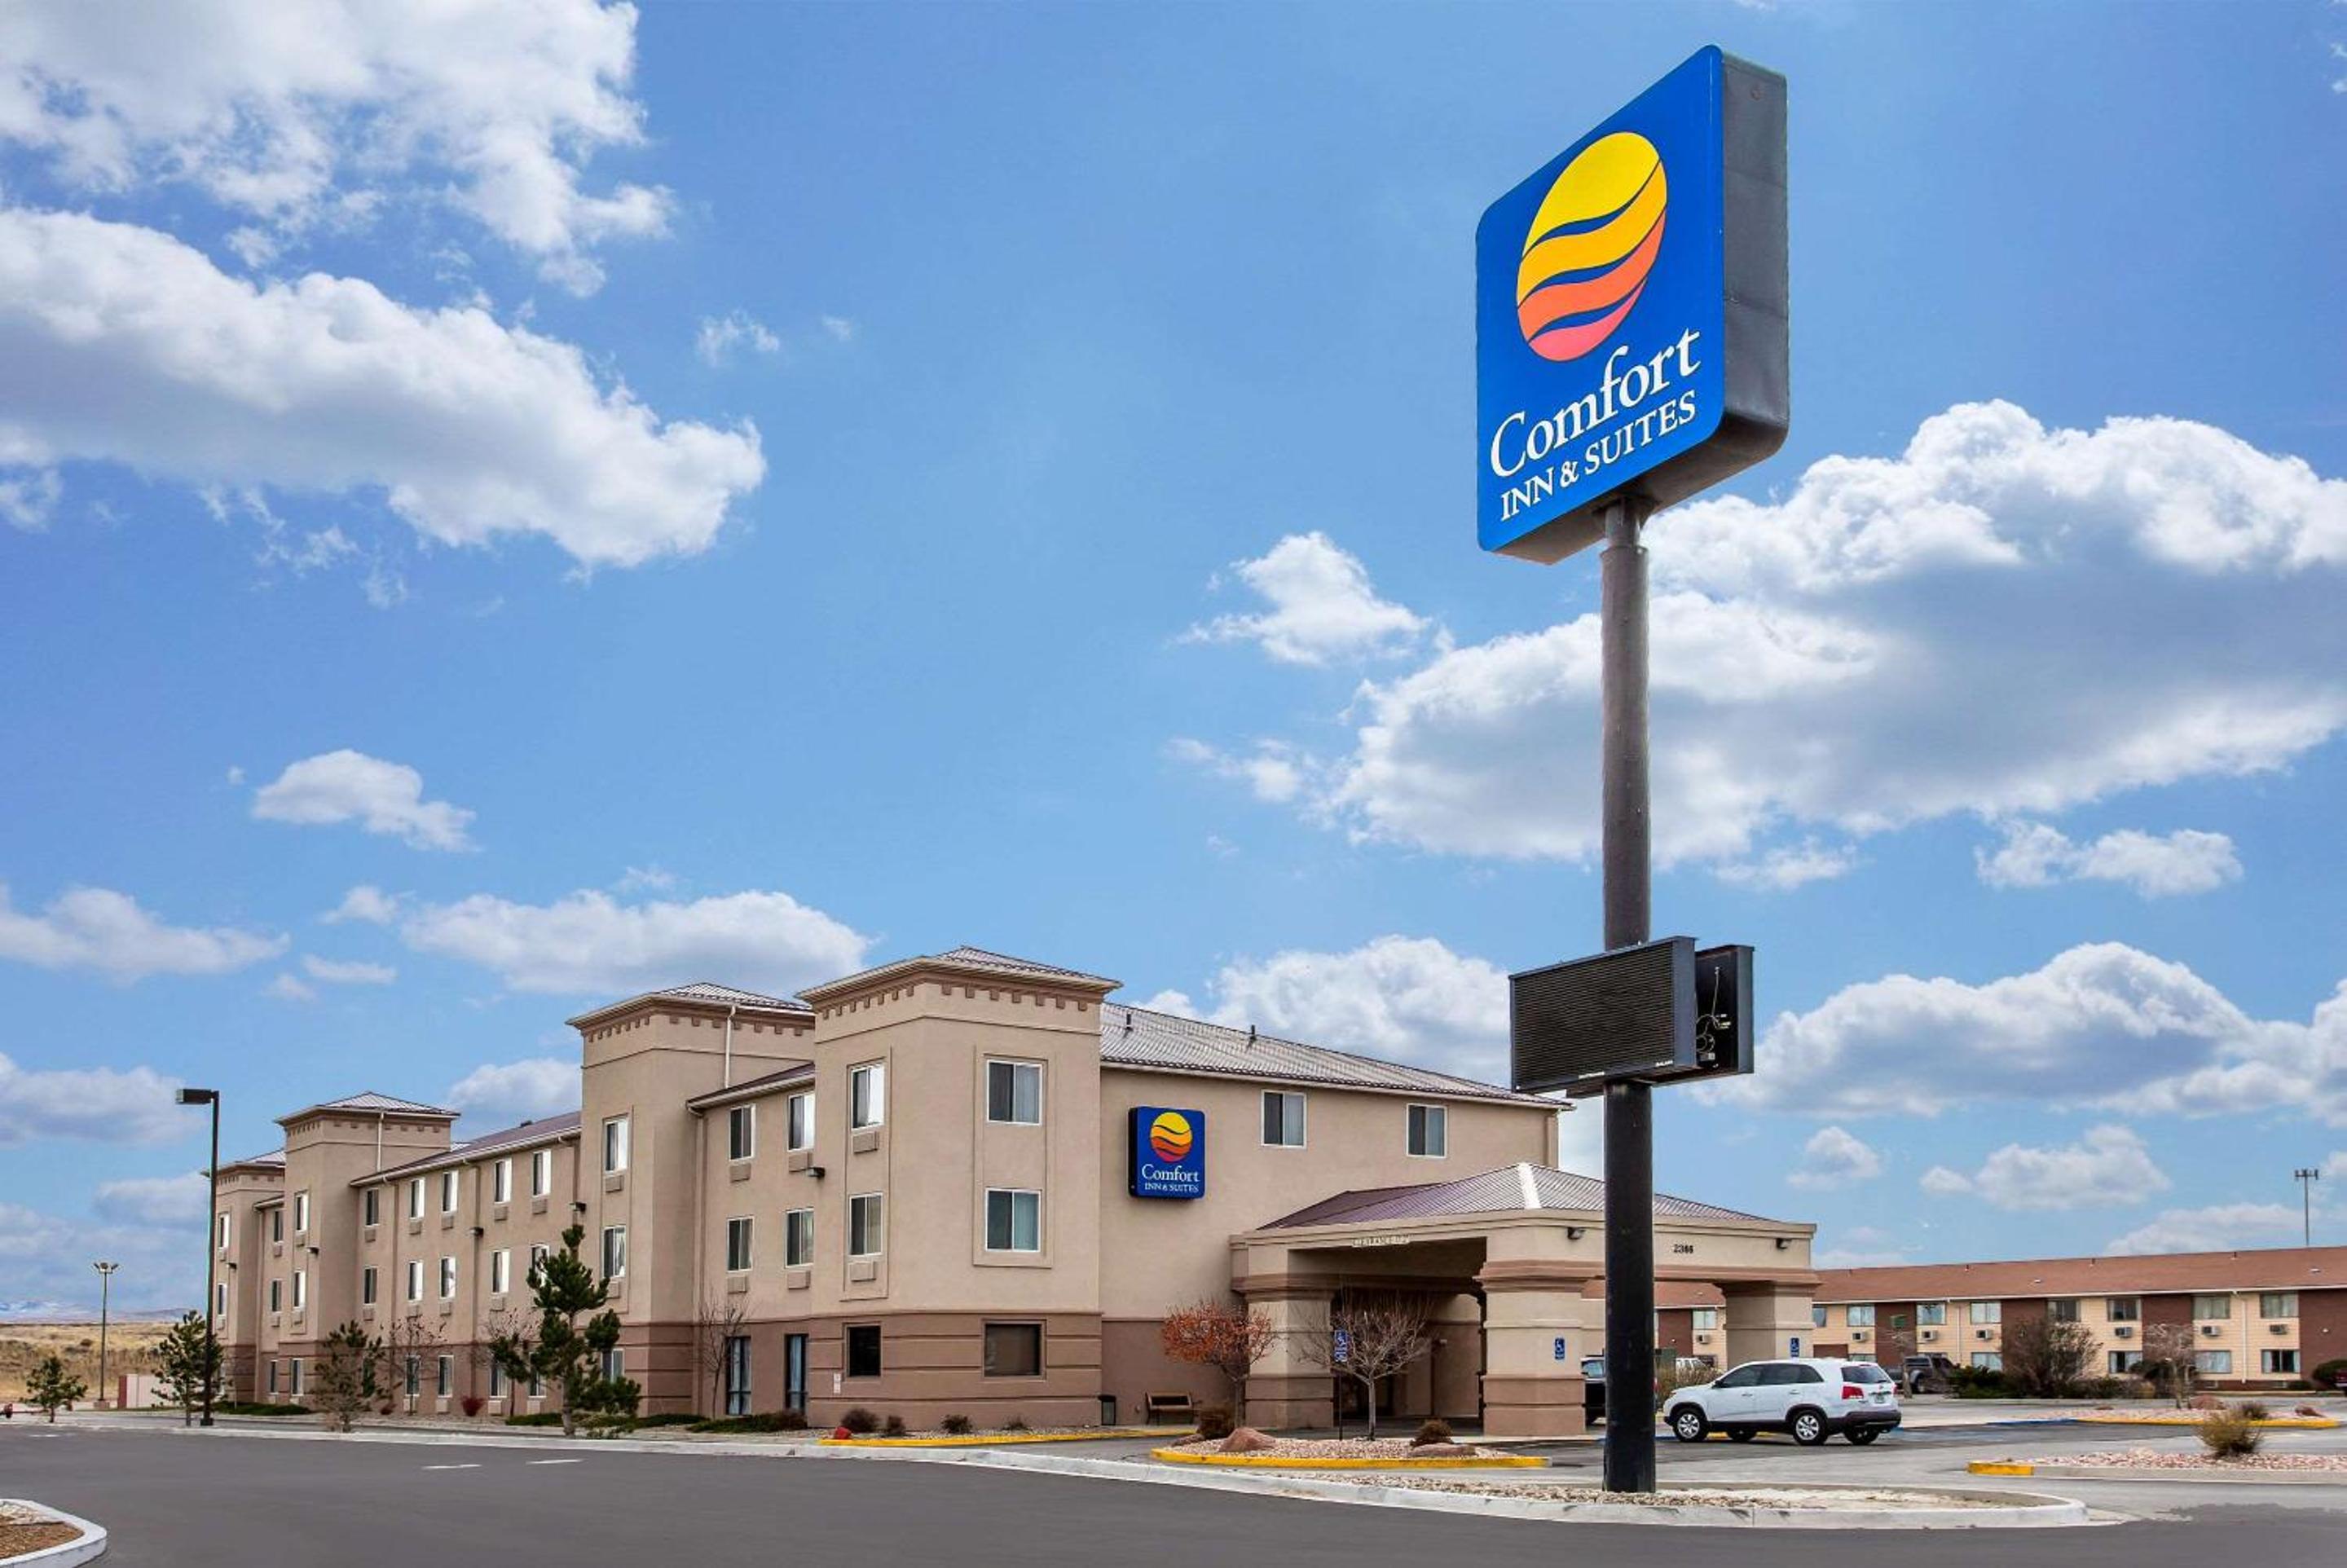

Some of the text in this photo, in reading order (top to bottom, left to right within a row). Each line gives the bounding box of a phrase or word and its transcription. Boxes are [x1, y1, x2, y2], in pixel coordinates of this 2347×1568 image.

[1491, 328, 1702, 478] Comfort
[1500, 390, 1696, 522] INN & SUITES
[1142, 1164, 1200, 1182] Comfort
[1169, 1183, 1200, 1193] SUITES
